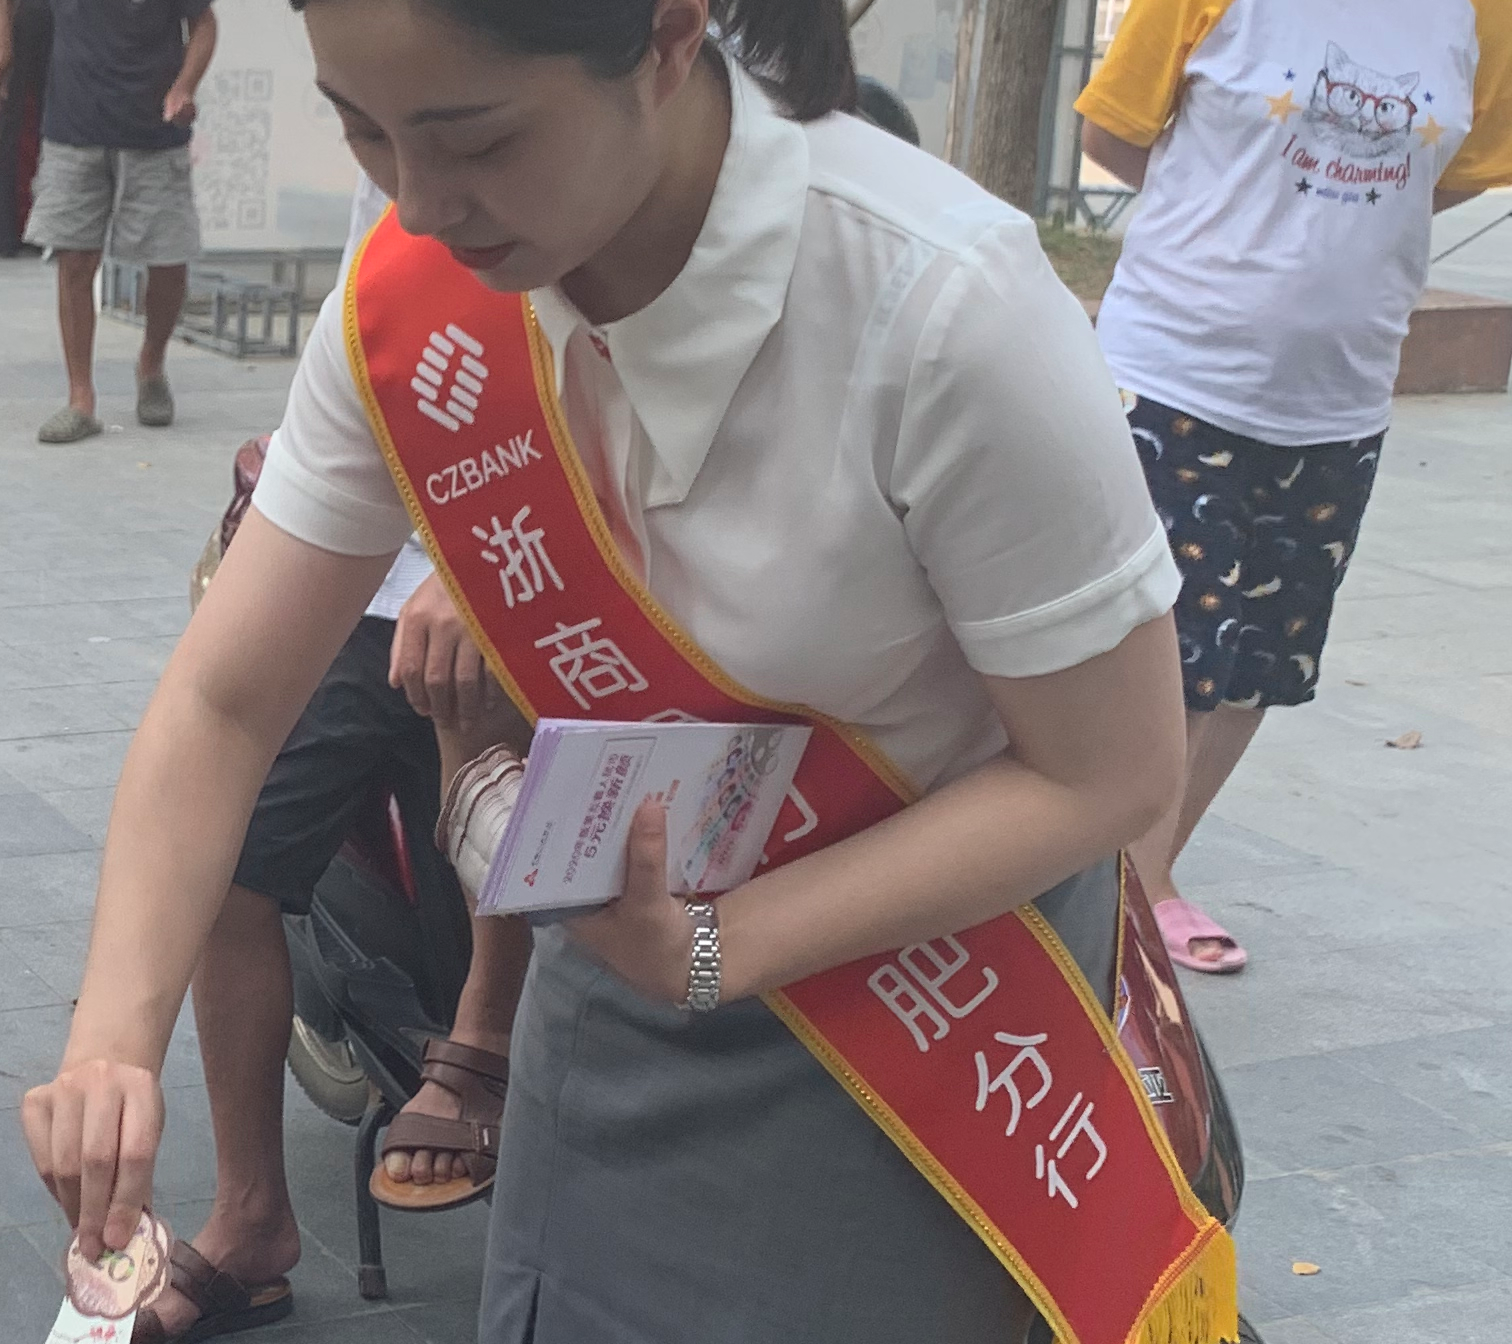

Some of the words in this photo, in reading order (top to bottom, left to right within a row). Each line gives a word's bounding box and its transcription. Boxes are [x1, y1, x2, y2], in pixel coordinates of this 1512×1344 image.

[1292, 147, 1320, 174] am
[1325, 152, 1411, 191] charming!
[426, 428, 543, 505] CZBANK
